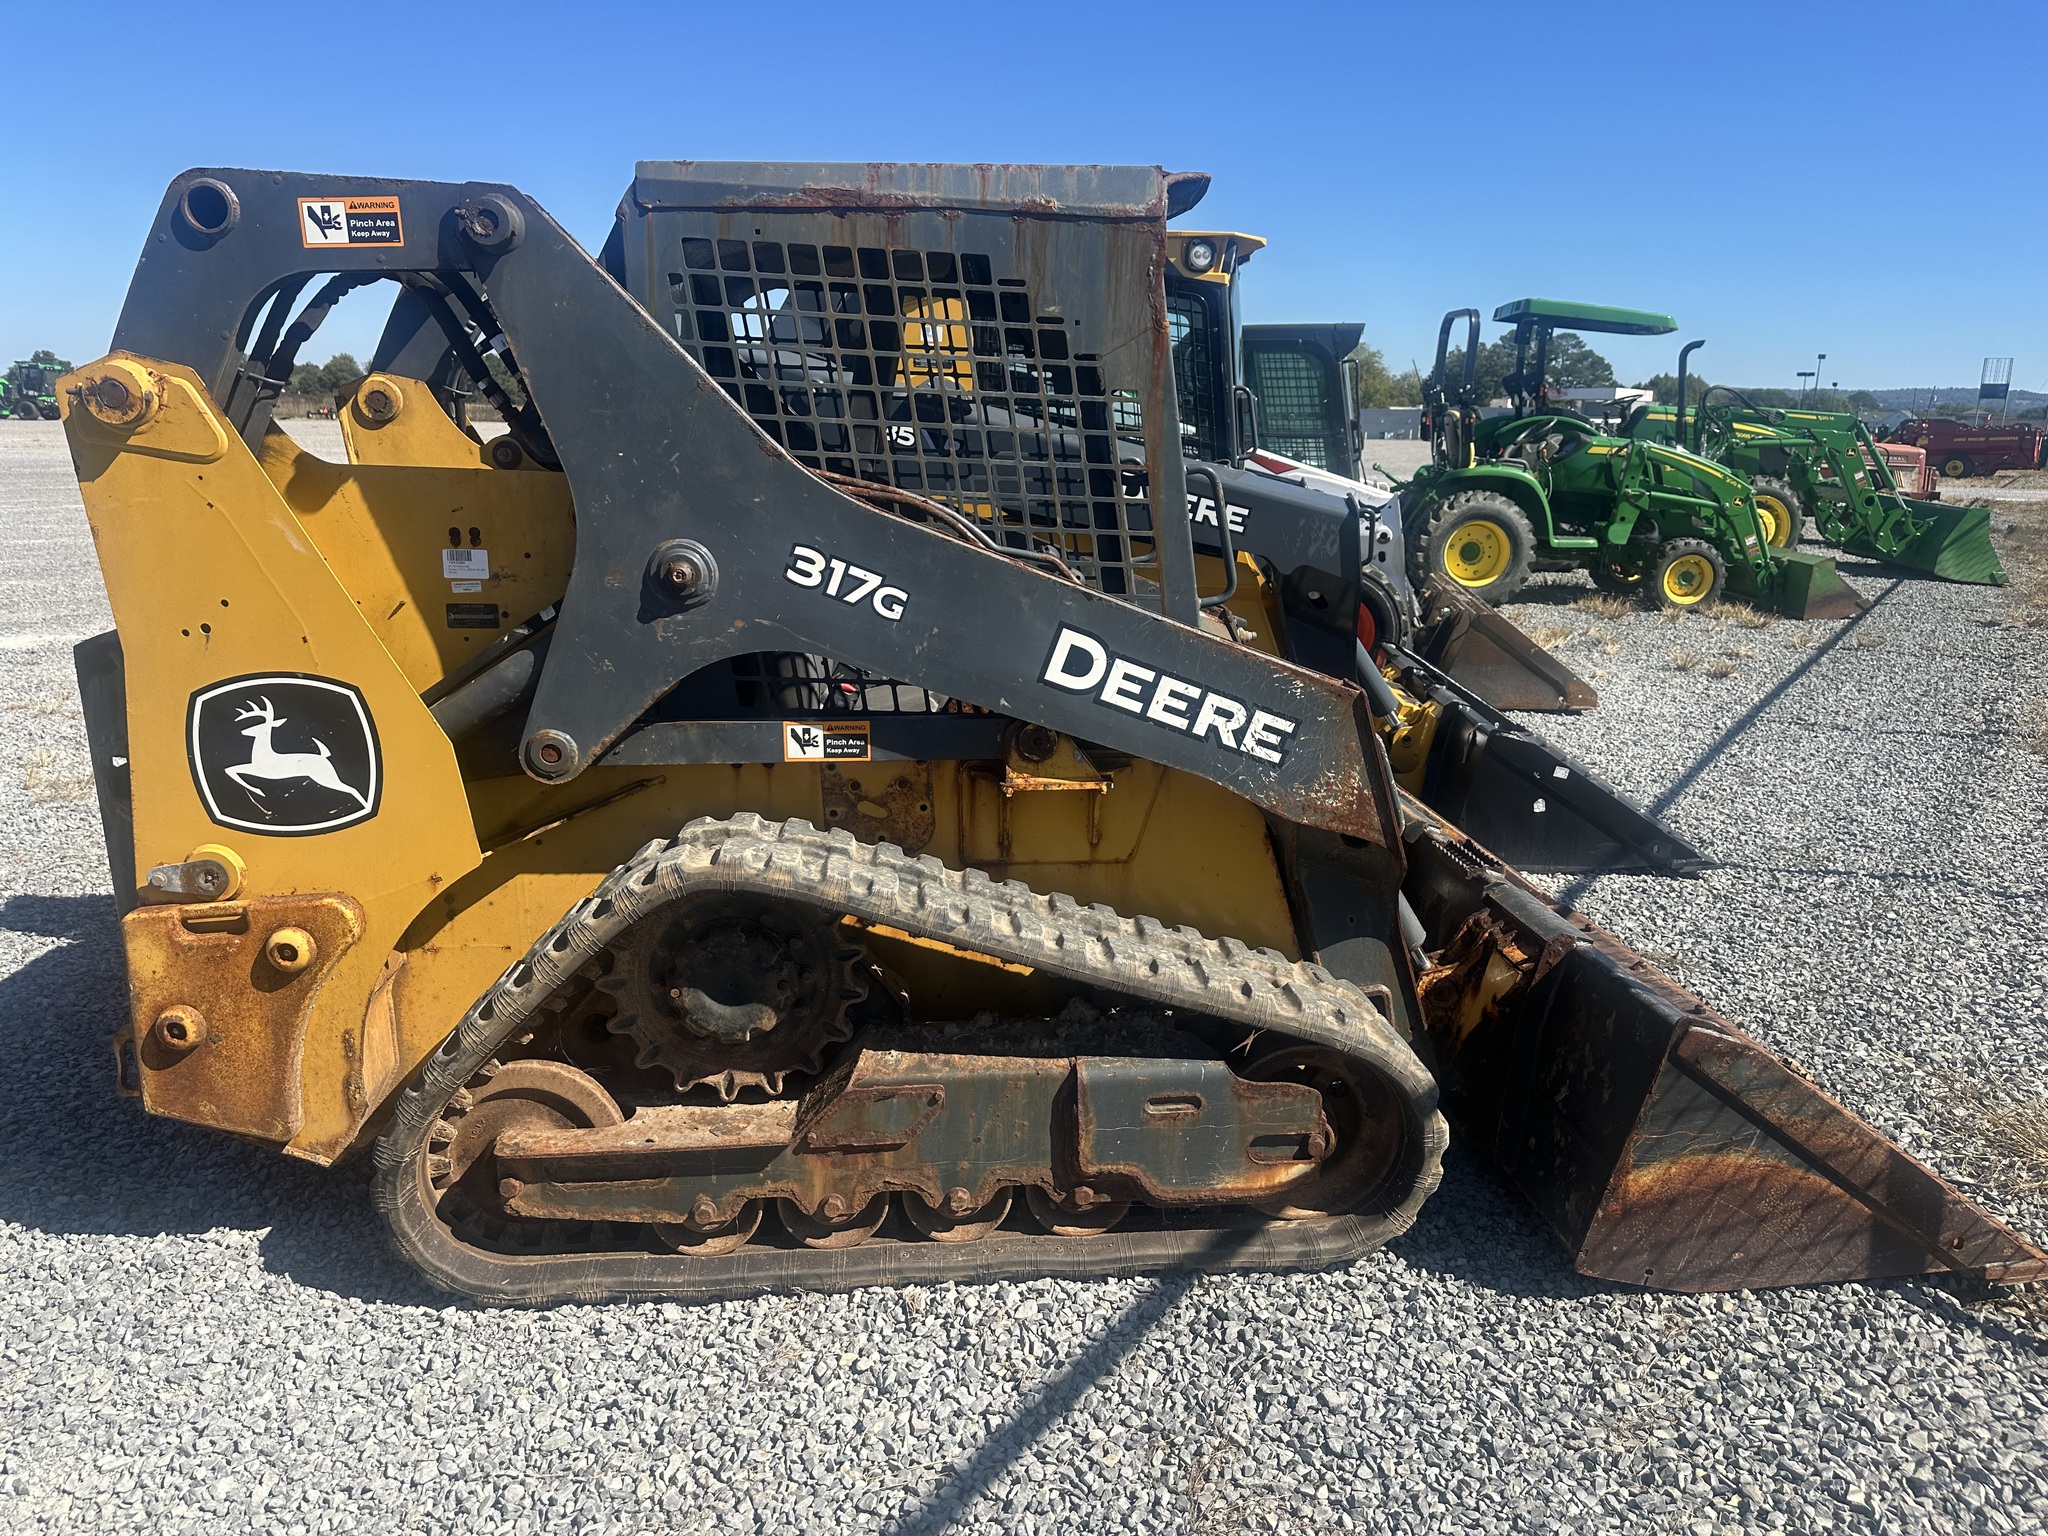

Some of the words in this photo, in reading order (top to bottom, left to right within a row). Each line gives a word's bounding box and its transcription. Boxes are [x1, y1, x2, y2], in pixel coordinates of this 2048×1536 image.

[357, 201, 395, 210] WARNING
[350, 219, 374, 228] Pinch
[376, 219, 396, 227] Area
[351, 230, 370, 238] Keep
[371, 230, 391, 238] Away
[786, 545, 909, 621] 317G
[1043, 627, 1296, 764] DEERE
